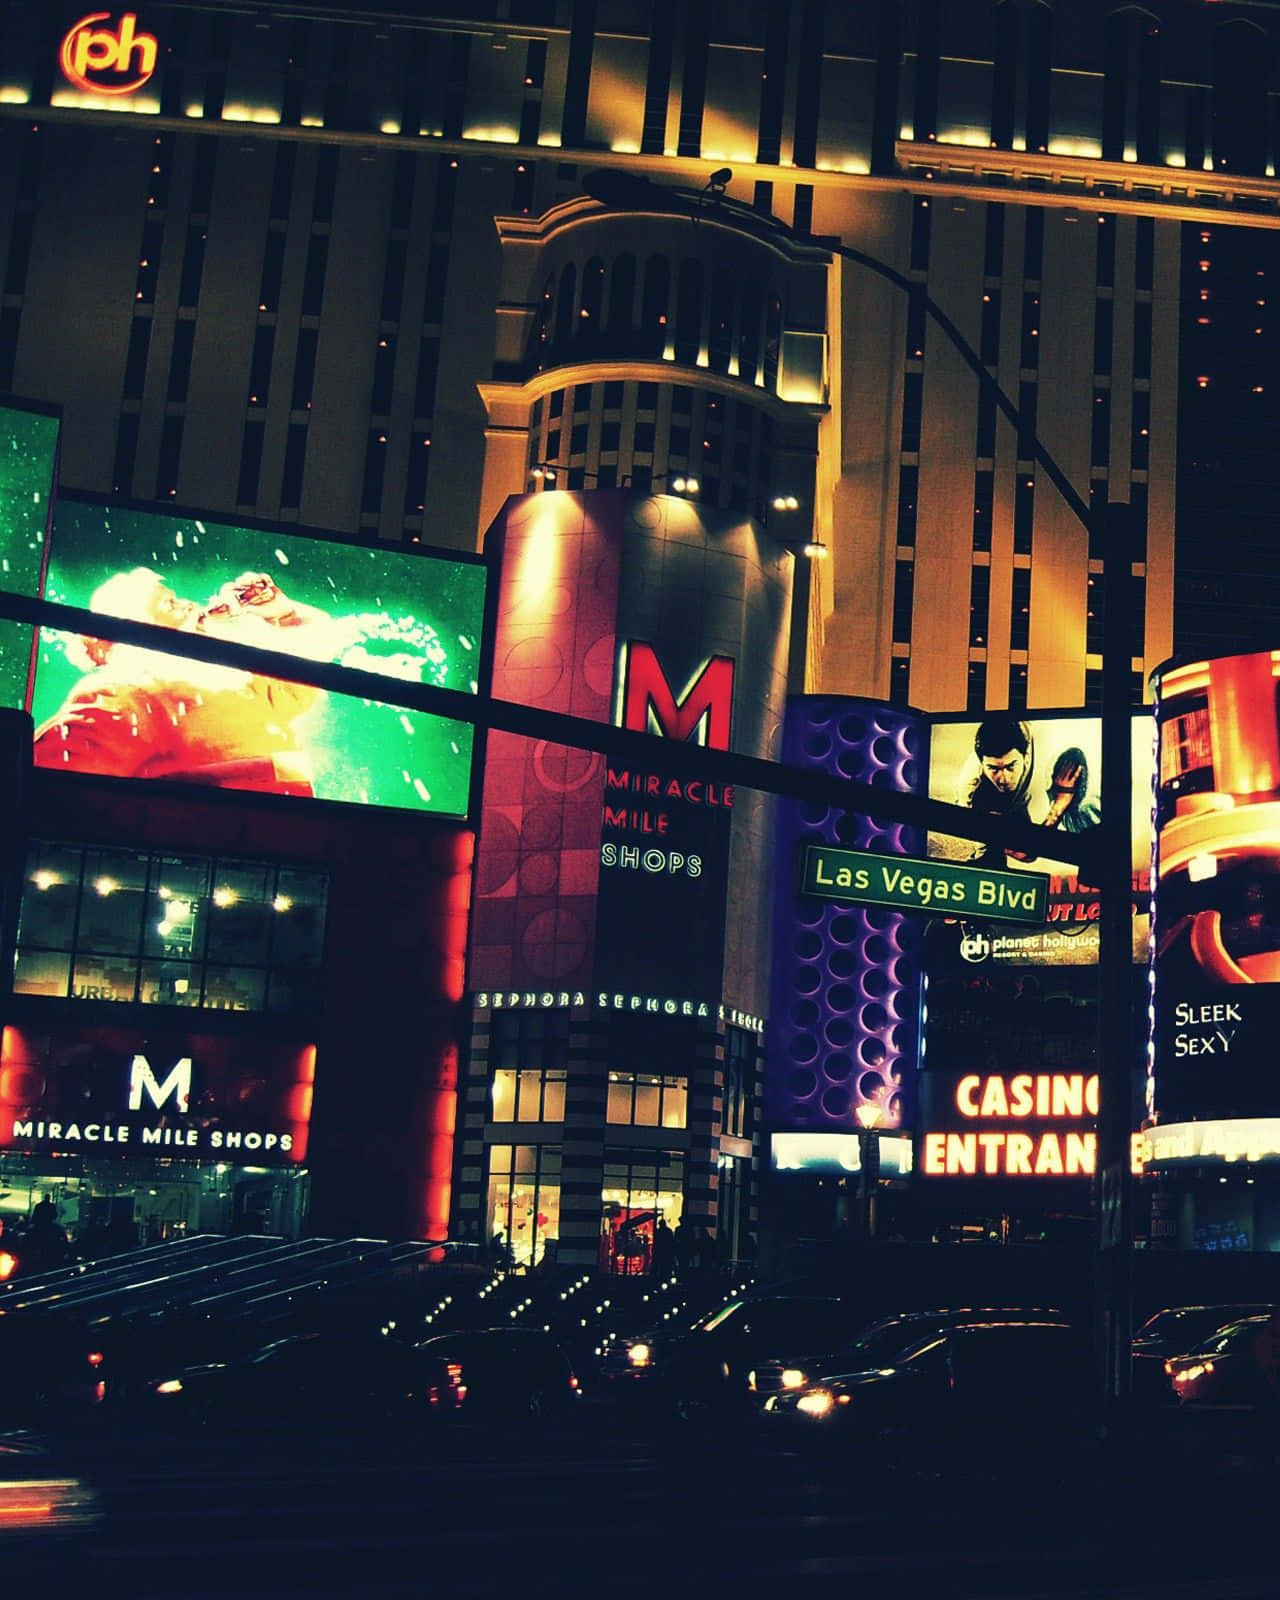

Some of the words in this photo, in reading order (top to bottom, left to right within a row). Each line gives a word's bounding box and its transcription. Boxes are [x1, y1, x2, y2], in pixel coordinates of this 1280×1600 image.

[74, 13, 157, 80] ph
[606, 767, 736, 808] MIRACLE
[603, 804, 669, 836] MILE
[601, 843, 702, 878] SHOPS
[815, 859, 870, 889] Las
[882, 867, 966, 905] Vegas
[977, 879, 1037, 911] Blvd
[992, 936, 1040, 952] planet
[478, 992, 585, 1009] SEPHORA
[598, 992, 709, 1017] SEPHORA
[1175, 1002, 1243, 1027] SLEEK
[1175, 1029, 1236, 1057] SEXY
[128, 1054, 193, 1113] M
[12, 1120, 130, 1143] MIRACLE
[142, 1127, 199, 1147] MILE
[210, 1131, 293, 1152] SHOPS
[923, 1131, 1145, 1175] ENTRANE
